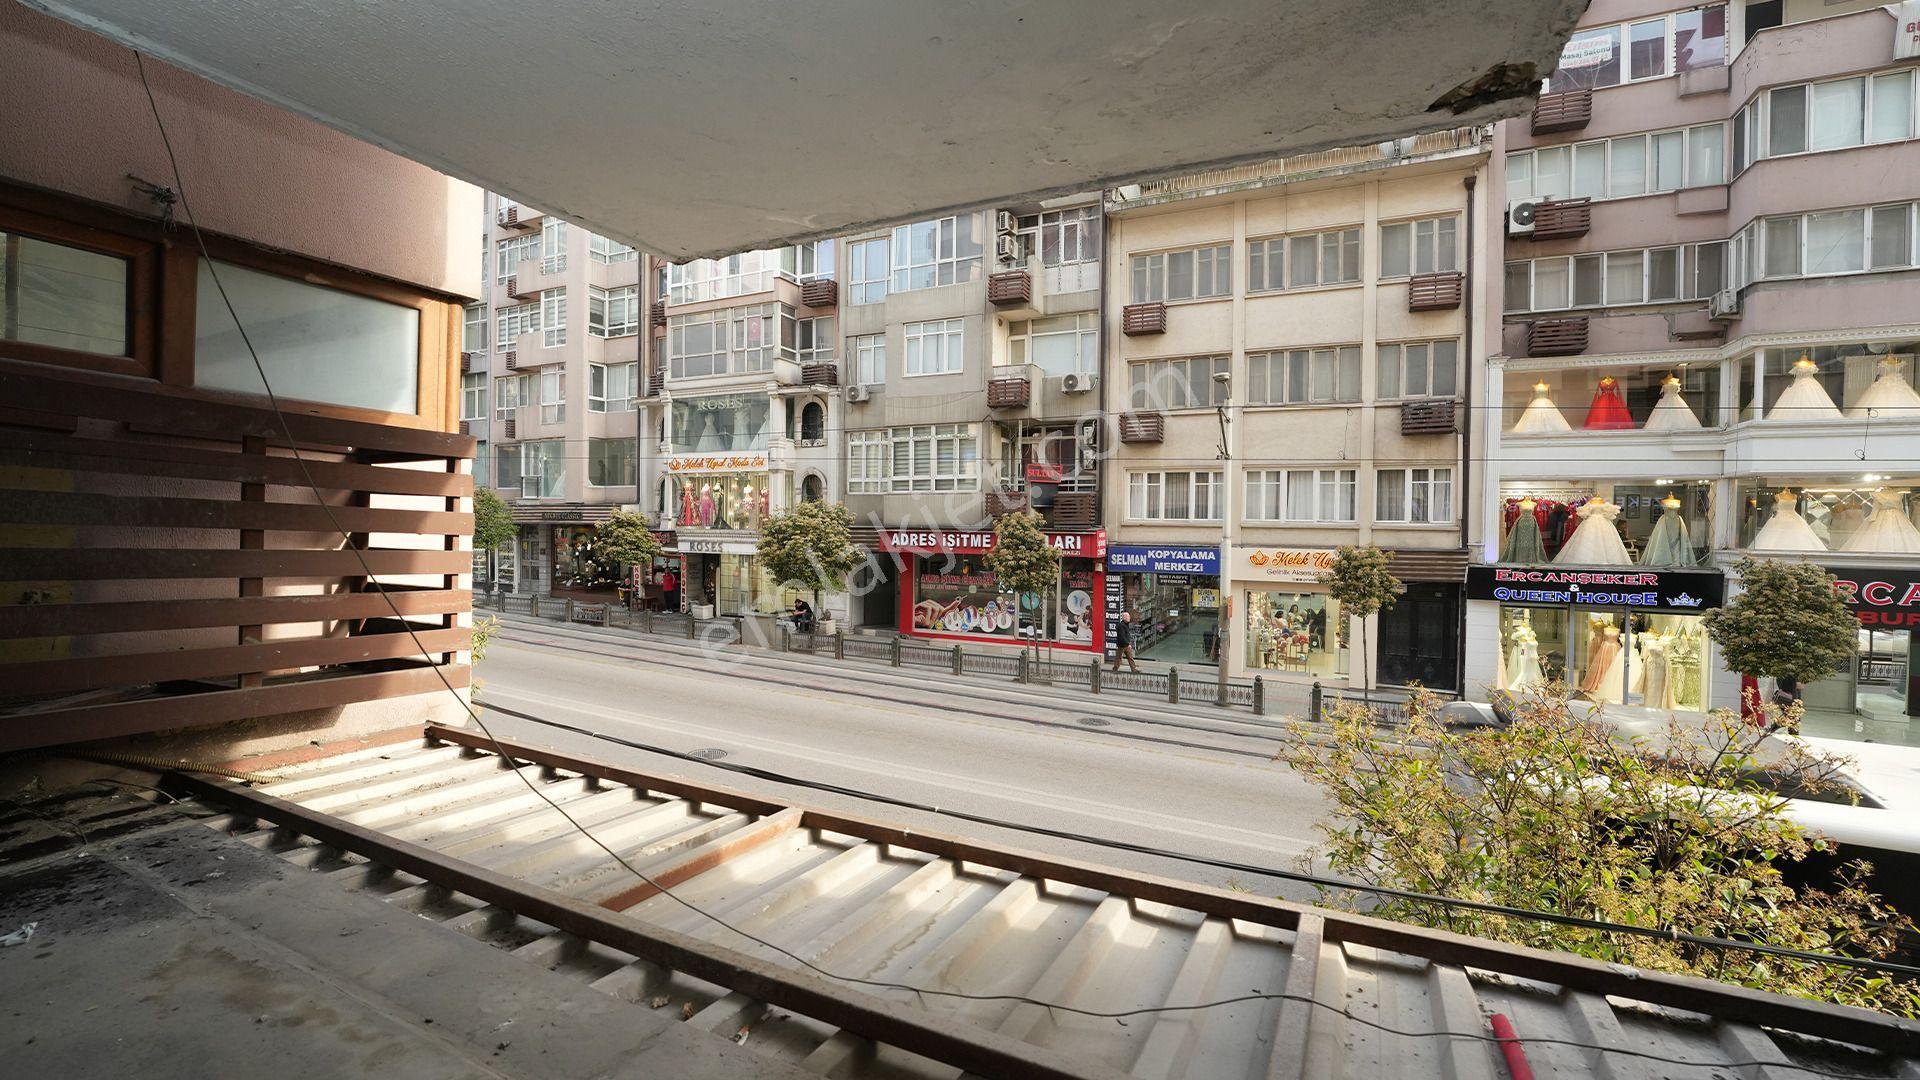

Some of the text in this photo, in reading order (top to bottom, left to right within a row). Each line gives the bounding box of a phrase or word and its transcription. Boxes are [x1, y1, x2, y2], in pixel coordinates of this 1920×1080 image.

[1584, 47, 1611, 57] Salonu
[697, 398, 744, 411] ROSES
[891, 533, 936, 546] ADRES
[689, 542, 723, 552] ROSES
[1111, 554, 1147, 566] SELMAN
[1147, 550, 1216, 560] KOPYALAMA
[1272, 551, 1310, 567] Melek
[1569, 584, 1580, 592] &
[1493, 587, 1658, 606] QUEEN HOUSE
